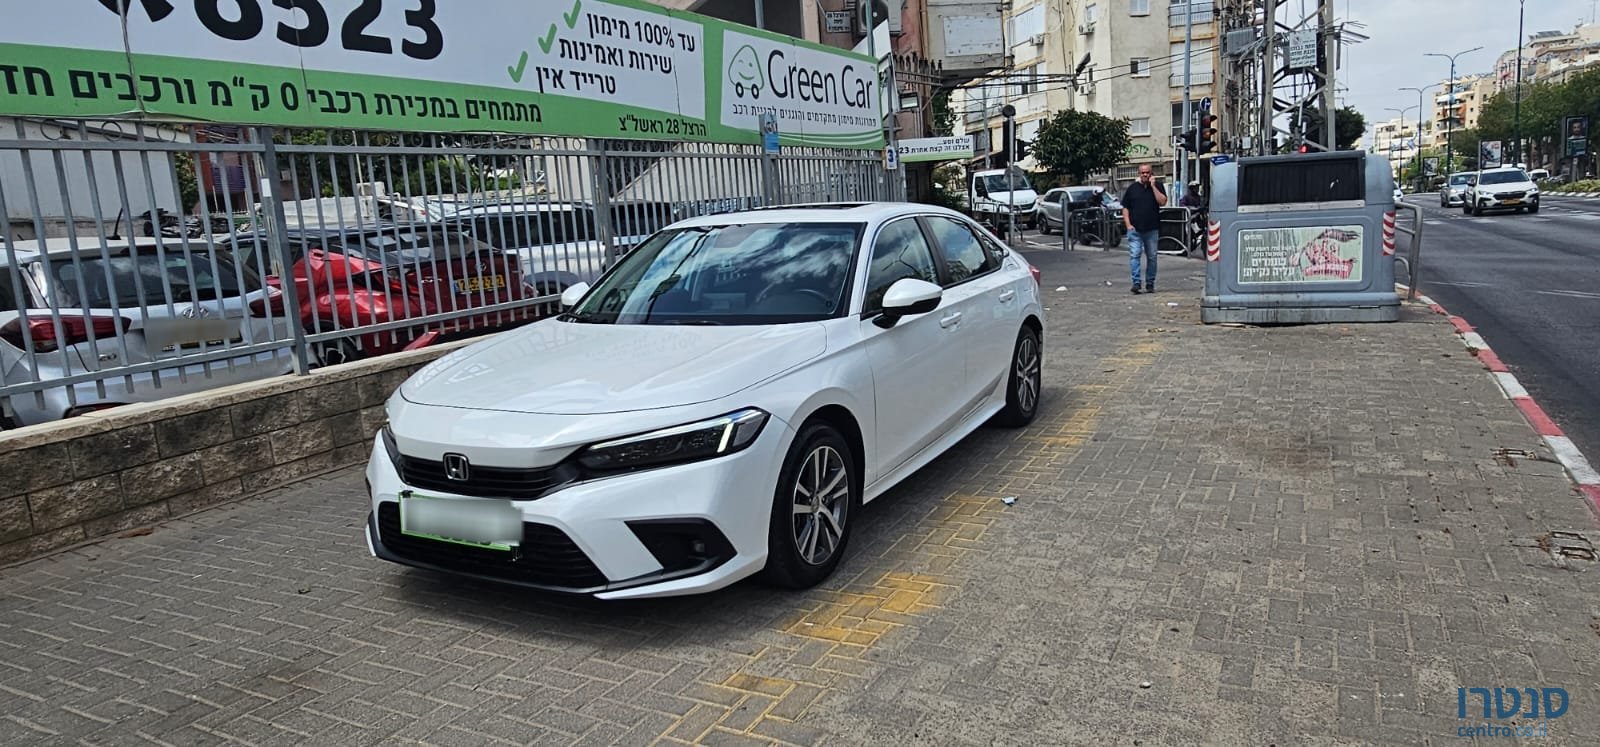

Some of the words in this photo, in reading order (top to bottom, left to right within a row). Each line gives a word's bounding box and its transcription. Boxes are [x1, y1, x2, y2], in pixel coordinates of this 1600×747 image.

[587, 13, 630, 40] מימון
[634, 21, 675, 49] 100%
[559, 38, 624, 67] ואמינות
[677, 32, 696, 53] עד
[629, 50, 672, 74] שירות
[68, 69, 197, 105] ורכבים
[535, 66, 566, 94] אין
[569, 70, 617, 95] טרייד
[767, 49, 838, 105] Green
[841, 64, 873, 109] Car
[280, 82, 299, 111] 0
[307, 88, 368, 115] רכבי
[374, 93, 460, 119] במכירת
[733, 103, 748, 116] רכב
[465, 99, 542, 123] מתמחים
[666, 118, 680, 135] 28
[681, 119, 706, 137] הרצל
